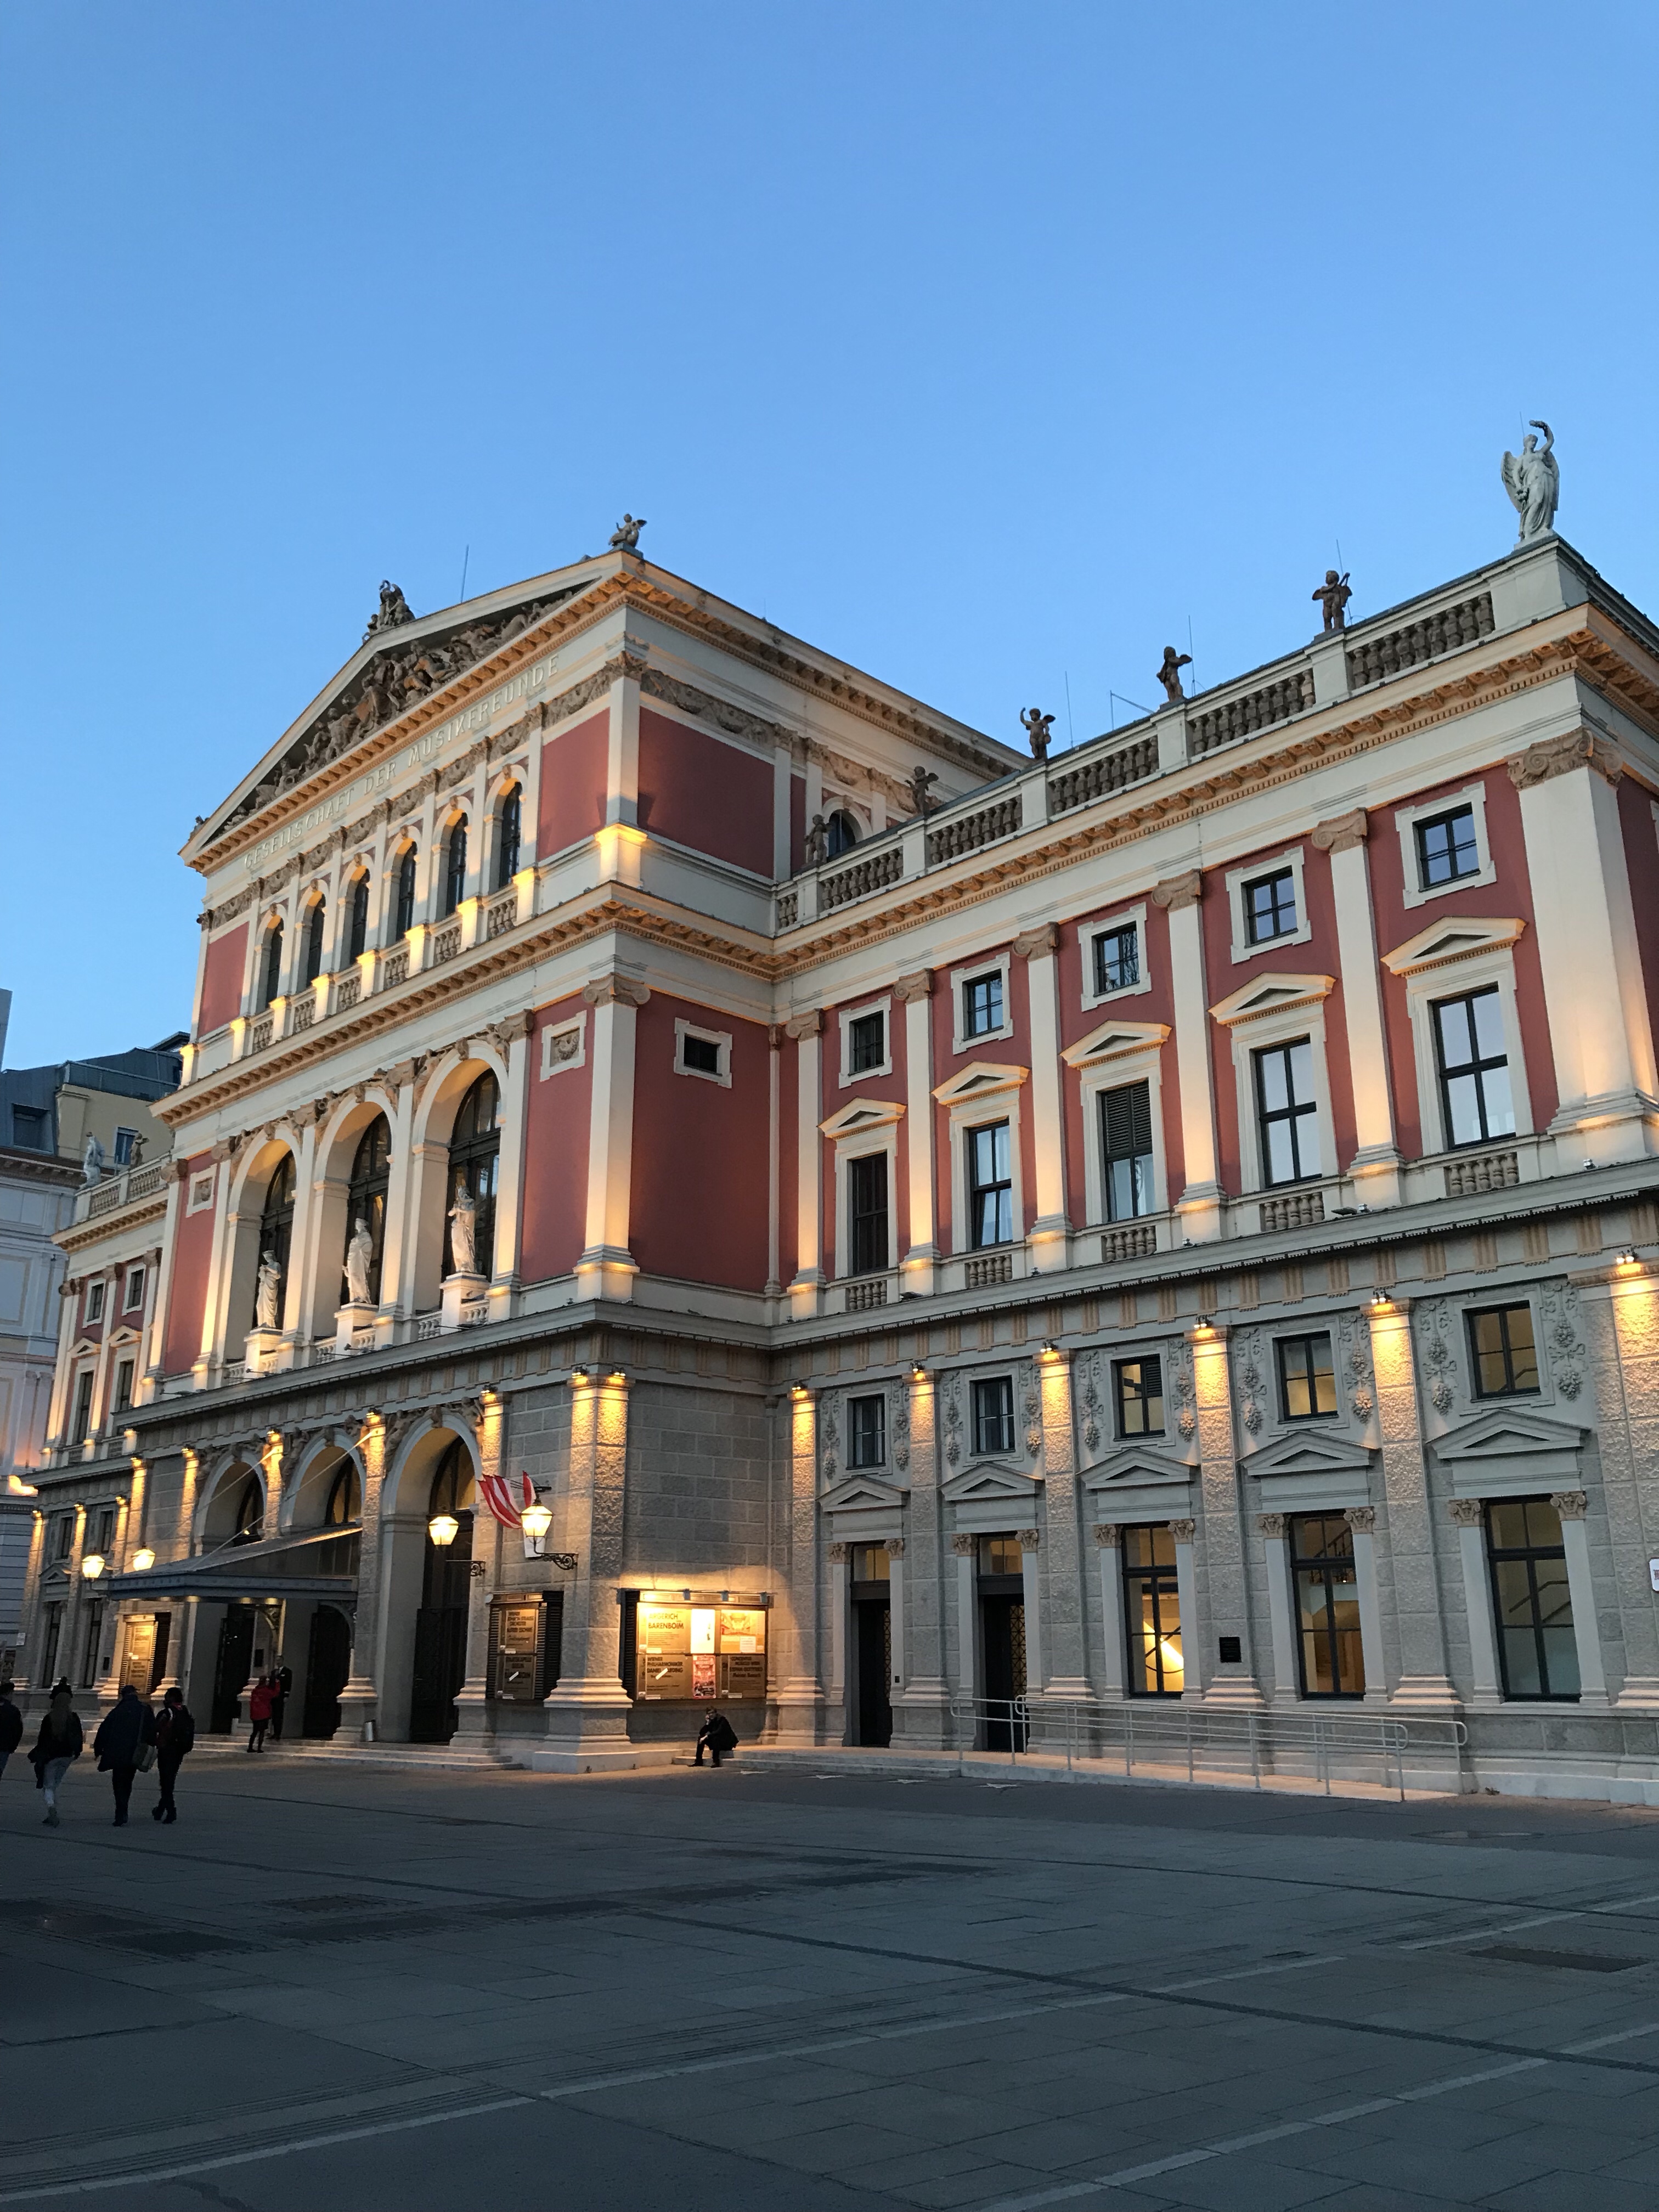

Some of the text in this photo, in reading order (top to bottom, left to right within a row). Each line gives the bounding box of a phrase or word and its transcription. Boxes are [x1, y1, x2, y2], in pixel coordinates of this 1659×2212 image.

[244, 653, 558, 870] GESELLSCHAFT DER MUSIKFREUNDE
